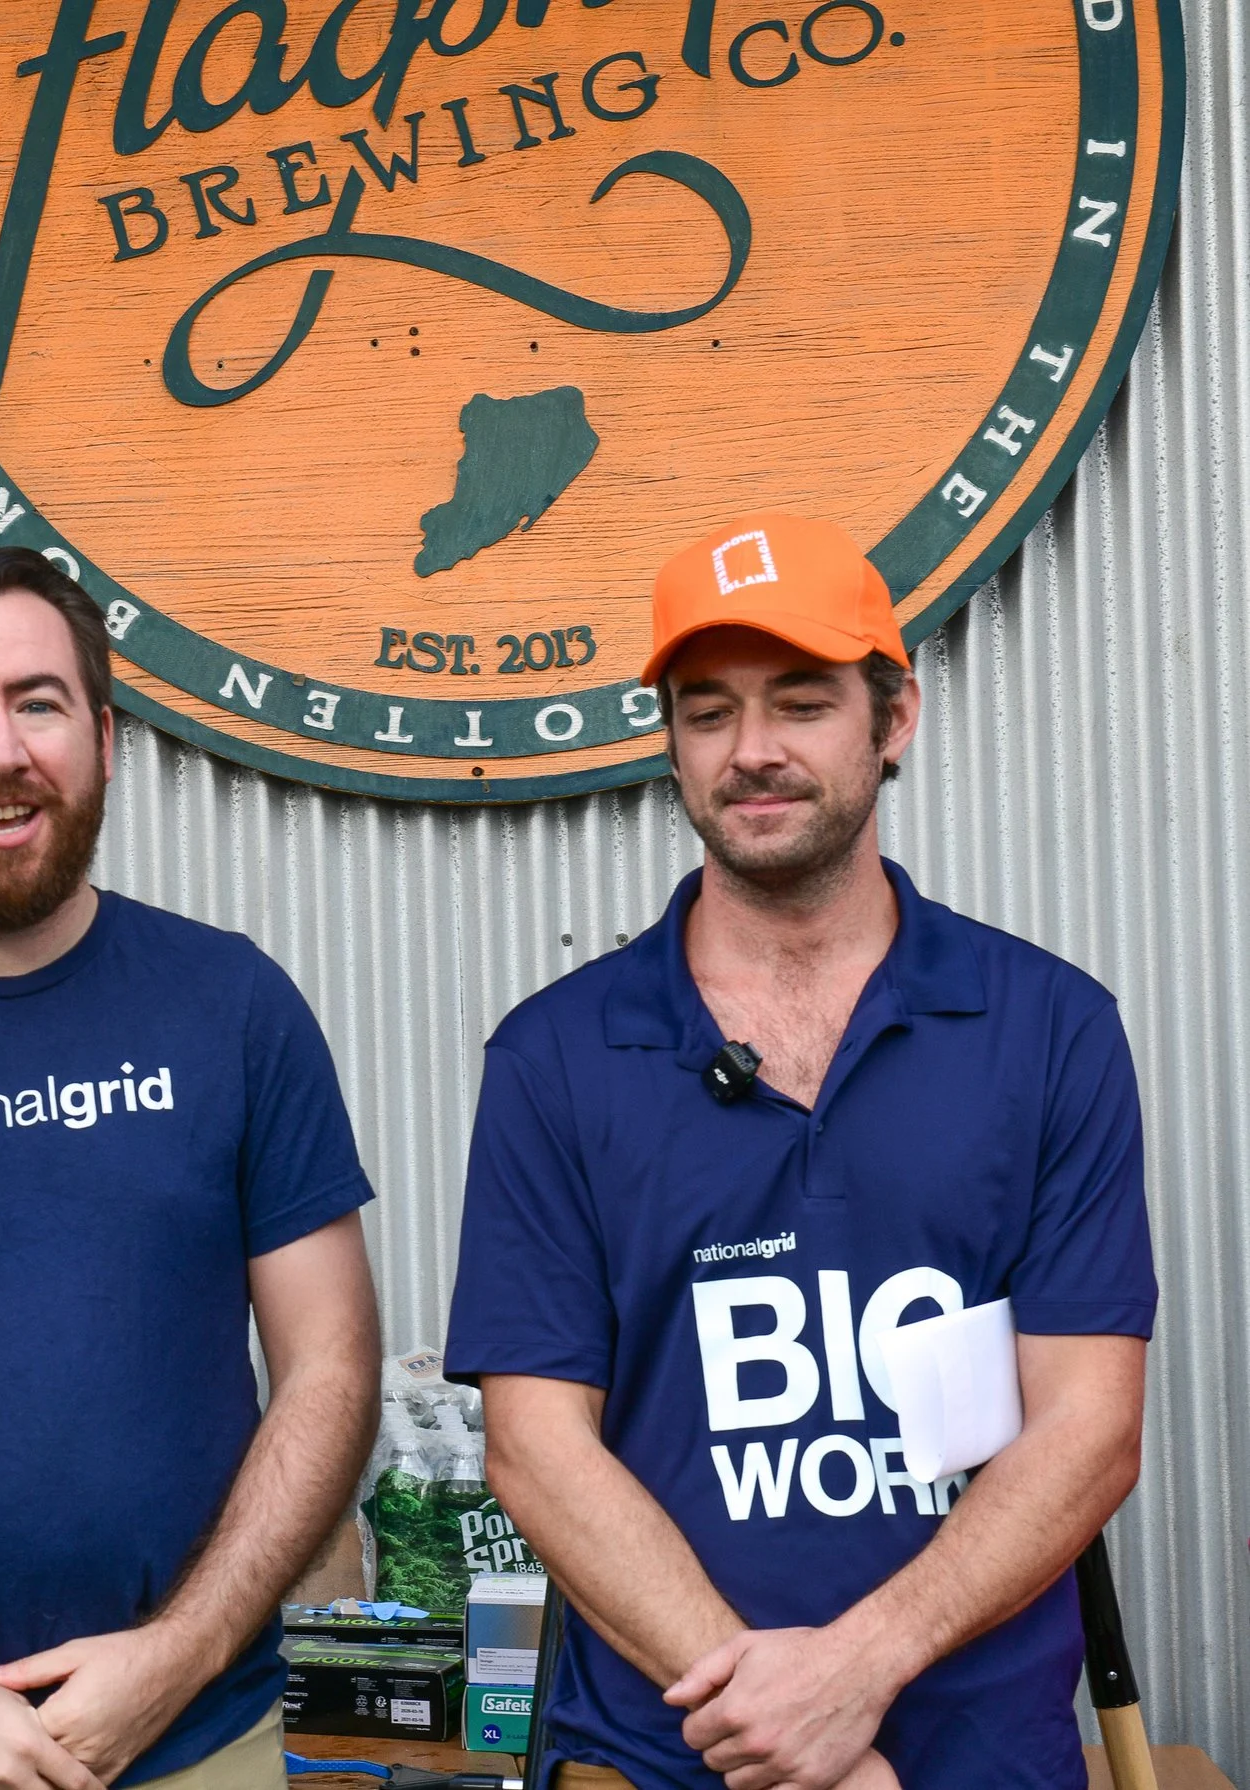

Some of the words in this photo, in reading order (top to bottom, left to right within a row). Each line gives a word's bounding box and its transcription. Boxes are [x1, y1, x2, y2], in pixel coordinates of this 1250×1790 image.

[98, 51, 661, 262] BREWING
[728, 0, 906, 88] CO.
[1073, 139, 1127, 248] IN
[942, 342, 1075, 519] THE
[373, 626, 480, 675] EST.
[497, 625, 597, 674] 2013
[218, 662, 662, 748] GOTTEN
[693, 1232, 796, 1263] nationalgrid
[710, 1434, 969, 1521] WOR
[463, 1537, 530, 1572] Spr
[512, 1561, 545, 1574] 1845
[486, 1697, 533, 1711] Safek
[483, 1729, 500, 1739] XL
